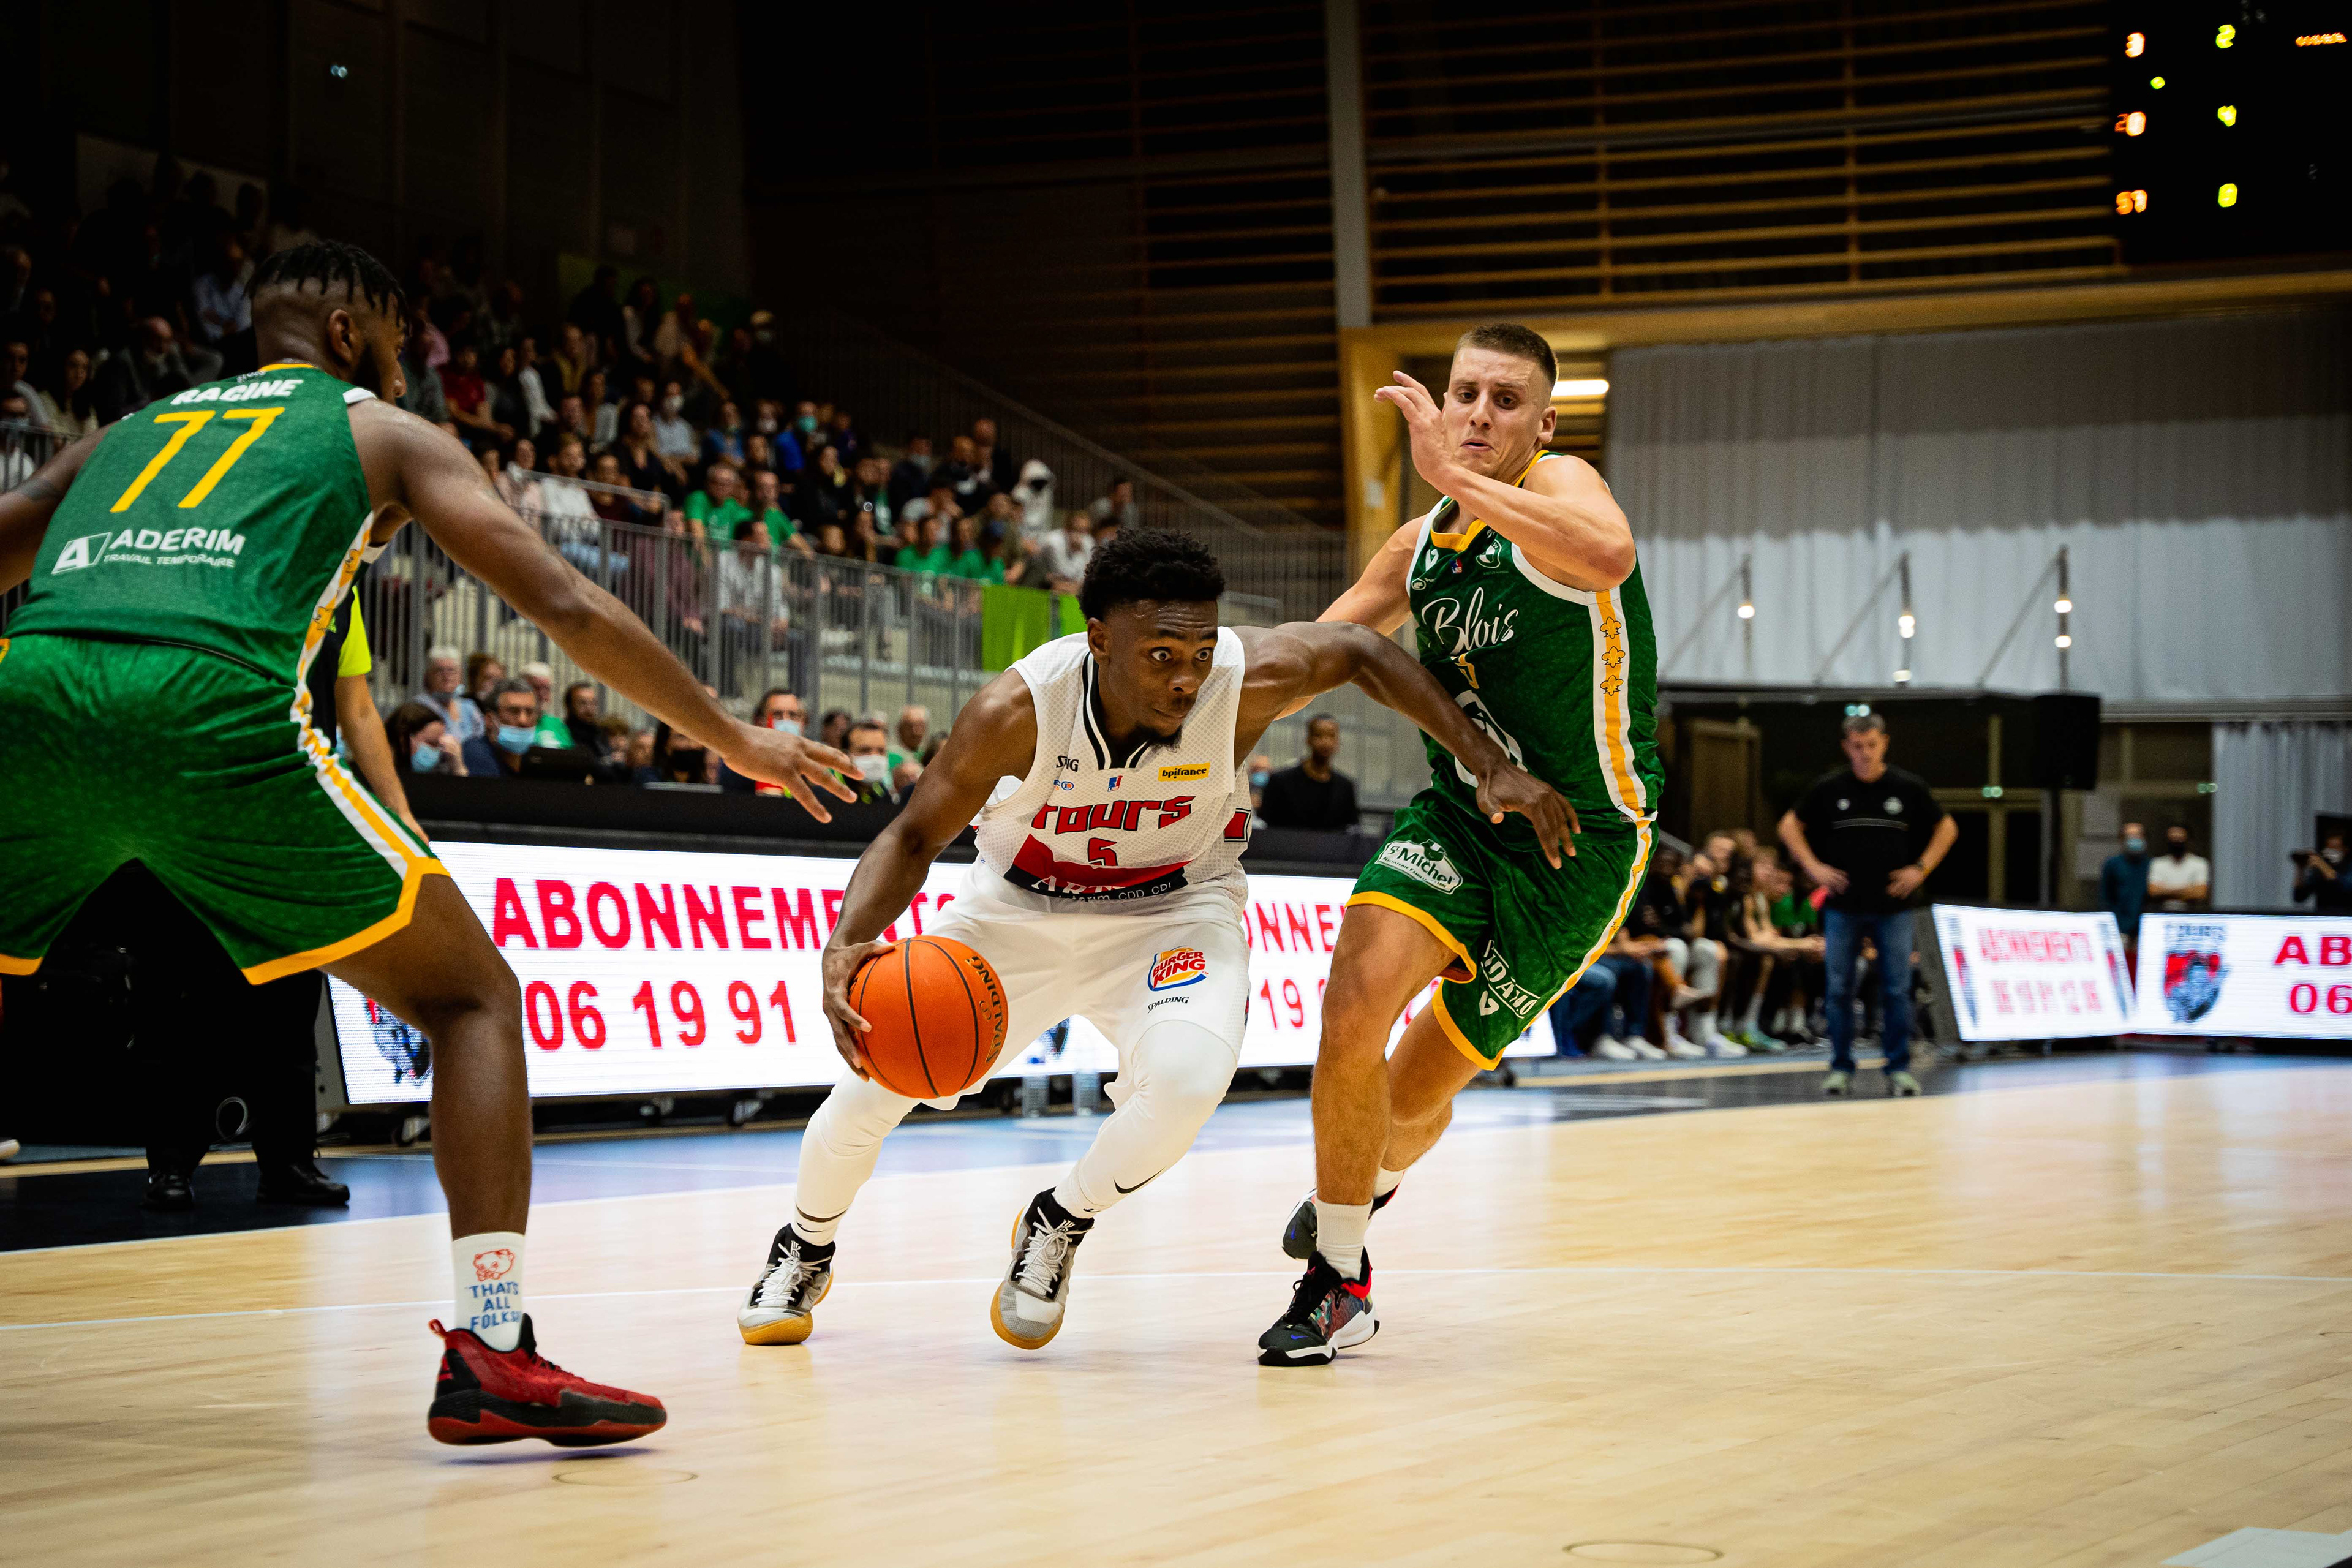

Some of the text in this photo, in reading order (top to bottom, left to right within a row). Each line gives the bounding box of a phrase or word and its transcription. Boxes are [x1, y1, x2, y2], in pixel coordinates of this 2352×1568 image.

[171, 380, 304, 405] RACINE
[110, 407, 285, 513] 77
[108, 528, 246, 556] ADERIM
[103, 554, 236, 568] TRAVAIL TEMPORAIRE
[1422, 587, 1518, 655] Blois
[1162, 767, 1207, 778] bpifrance
[1397, 848, 1453, 885] Michel
[1118, 889, 1145, 900] CDD
[1153, 951, 1204, 978] BURGER
[2274, 935, 2352, 965] AB
[1153, 959, 1205, 989] KING
[1148, 996, 1189, 1014] SPALDING
[1260, 979, 1304, 1030] 19
[2290, 983, 2352, 1014] 06
[525, 980, 797, 1051] 06 19 91
[483, 1296, 510, 1312] ALL
